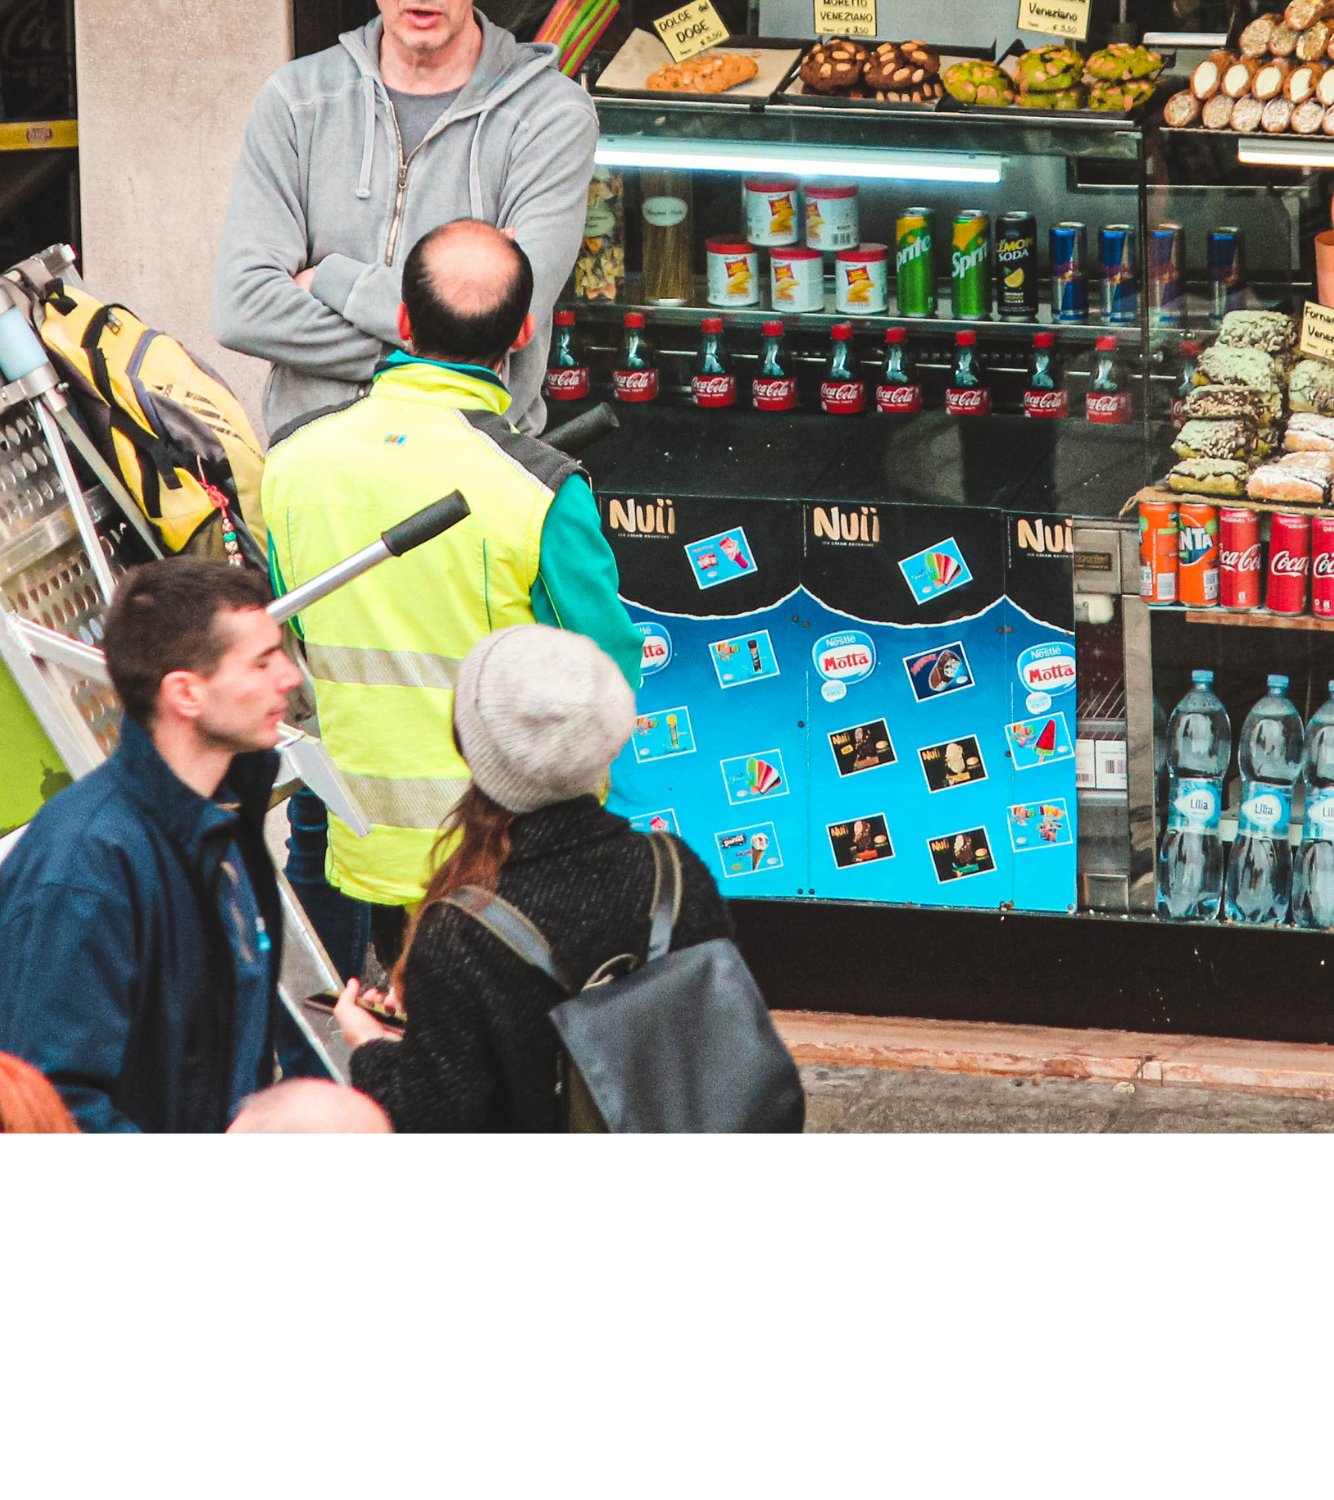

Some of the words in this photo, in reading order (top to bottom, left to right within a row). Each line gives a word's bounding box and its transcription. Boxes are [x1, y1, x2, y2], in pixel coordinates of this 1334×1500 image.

[658, 9, 692, 32] DOLCE
[820, 11, 874, 23] VENEZIANO
[1028, 1, 1078, 22] Veneziano
[675, 19, 710, 43] DOGE
[896, 234, 931, 272] prite
[952, 241, 987, 279] Sprit
[998, 248, 1029, 262] SODA
[608, 497, 676, 535] Nuii
[813, 505, 880, 543] Nuii
[1017, 518, 1073, 553] Nui
[1179, 526, 1214, 551] NTA
[825, 634, 857, 647] Nestlé
[643, 644, 665, 658] tta
[1030, 646, 1062, 659] Nestlé
[823, 655, 869, 672] Motta
[1028, 665, 1075, 683] Motta
[1190, 799, 1209, 811] Lilia
[1254, 803, 1274, 815] Lilia
